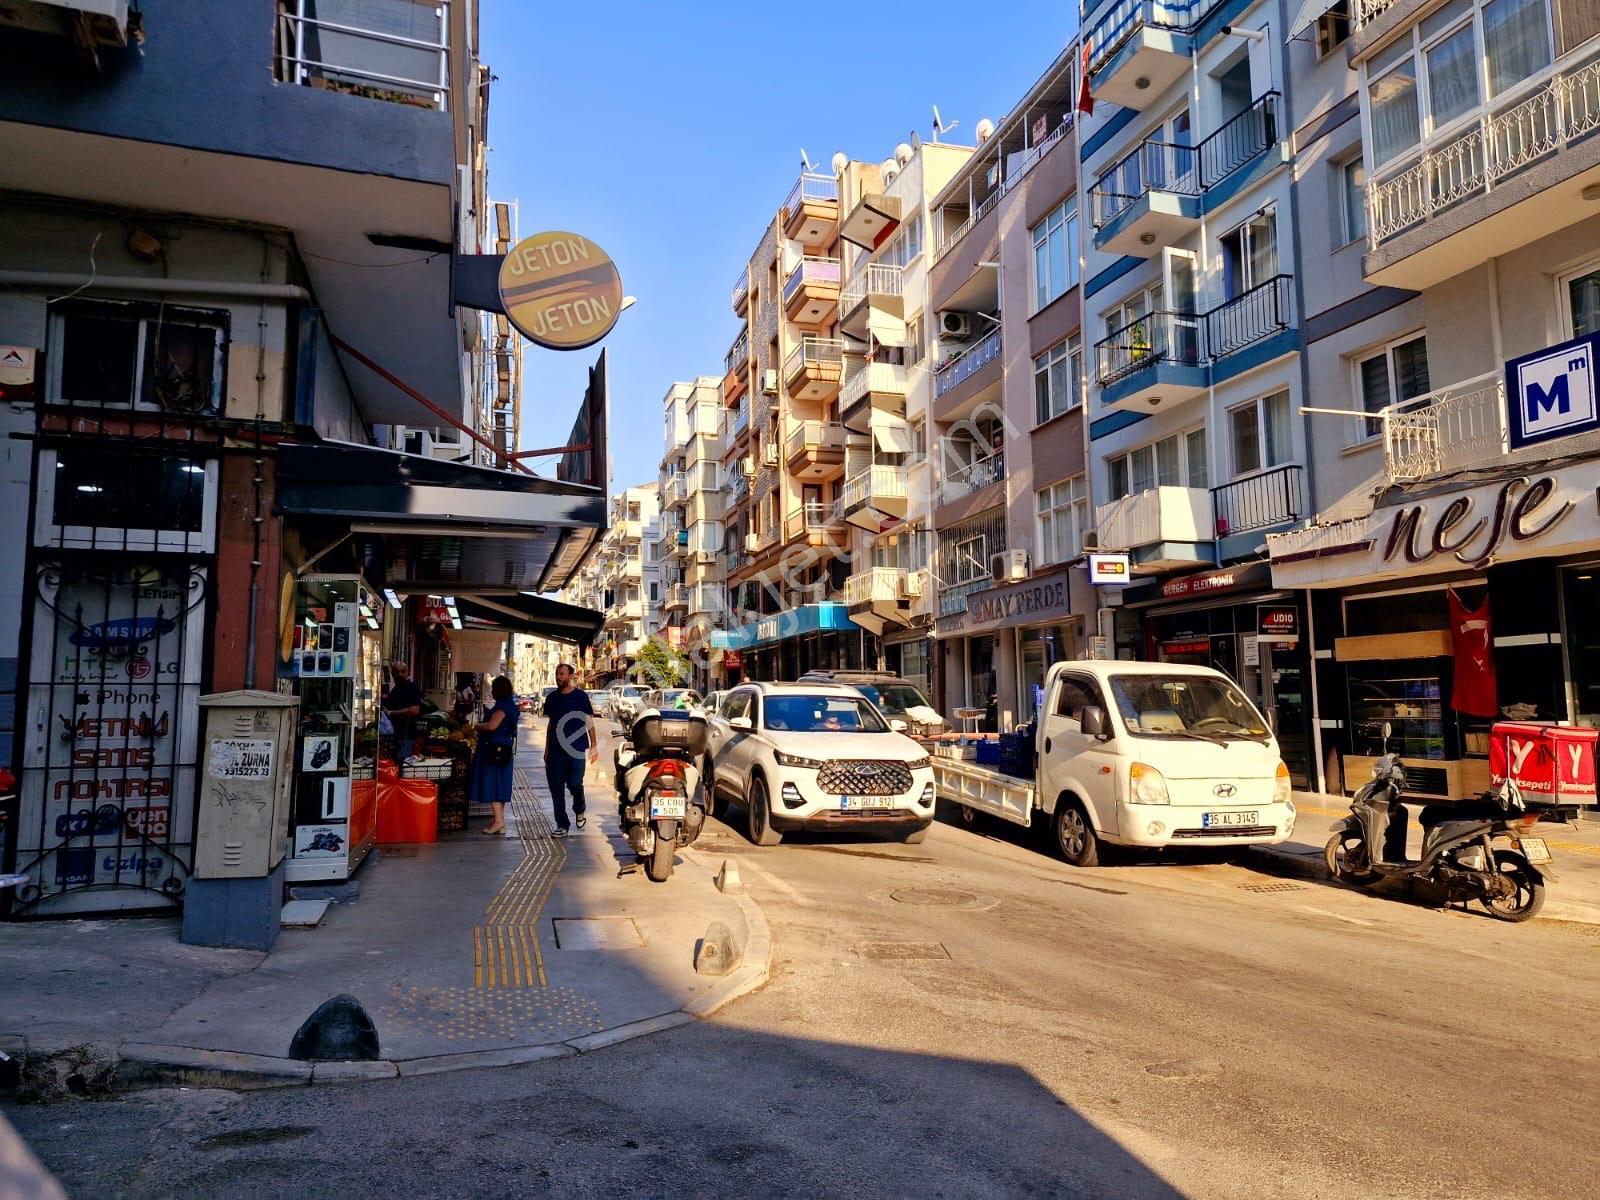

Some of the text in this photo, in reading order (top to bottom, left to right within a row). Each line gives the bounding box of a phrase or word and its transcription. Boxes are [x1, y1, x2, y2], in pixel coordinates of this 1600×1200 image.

[510, 236, 590, 276] JETON
[533, 295, 612, 337] JETON
[1015, 582, 1065, 616] PERDE
[156, 661, 179, 674] LG
[96, 689, 161, 705] iPhone
[240, 752, 270, 767] ZURNA
[261, 768, 270, 777] 23
[1492, 773, 1551, 790] Yeksepeti
[847, 797, 857, 806] 34
[1209, 813, 1256, 825] 35 AL 3145
